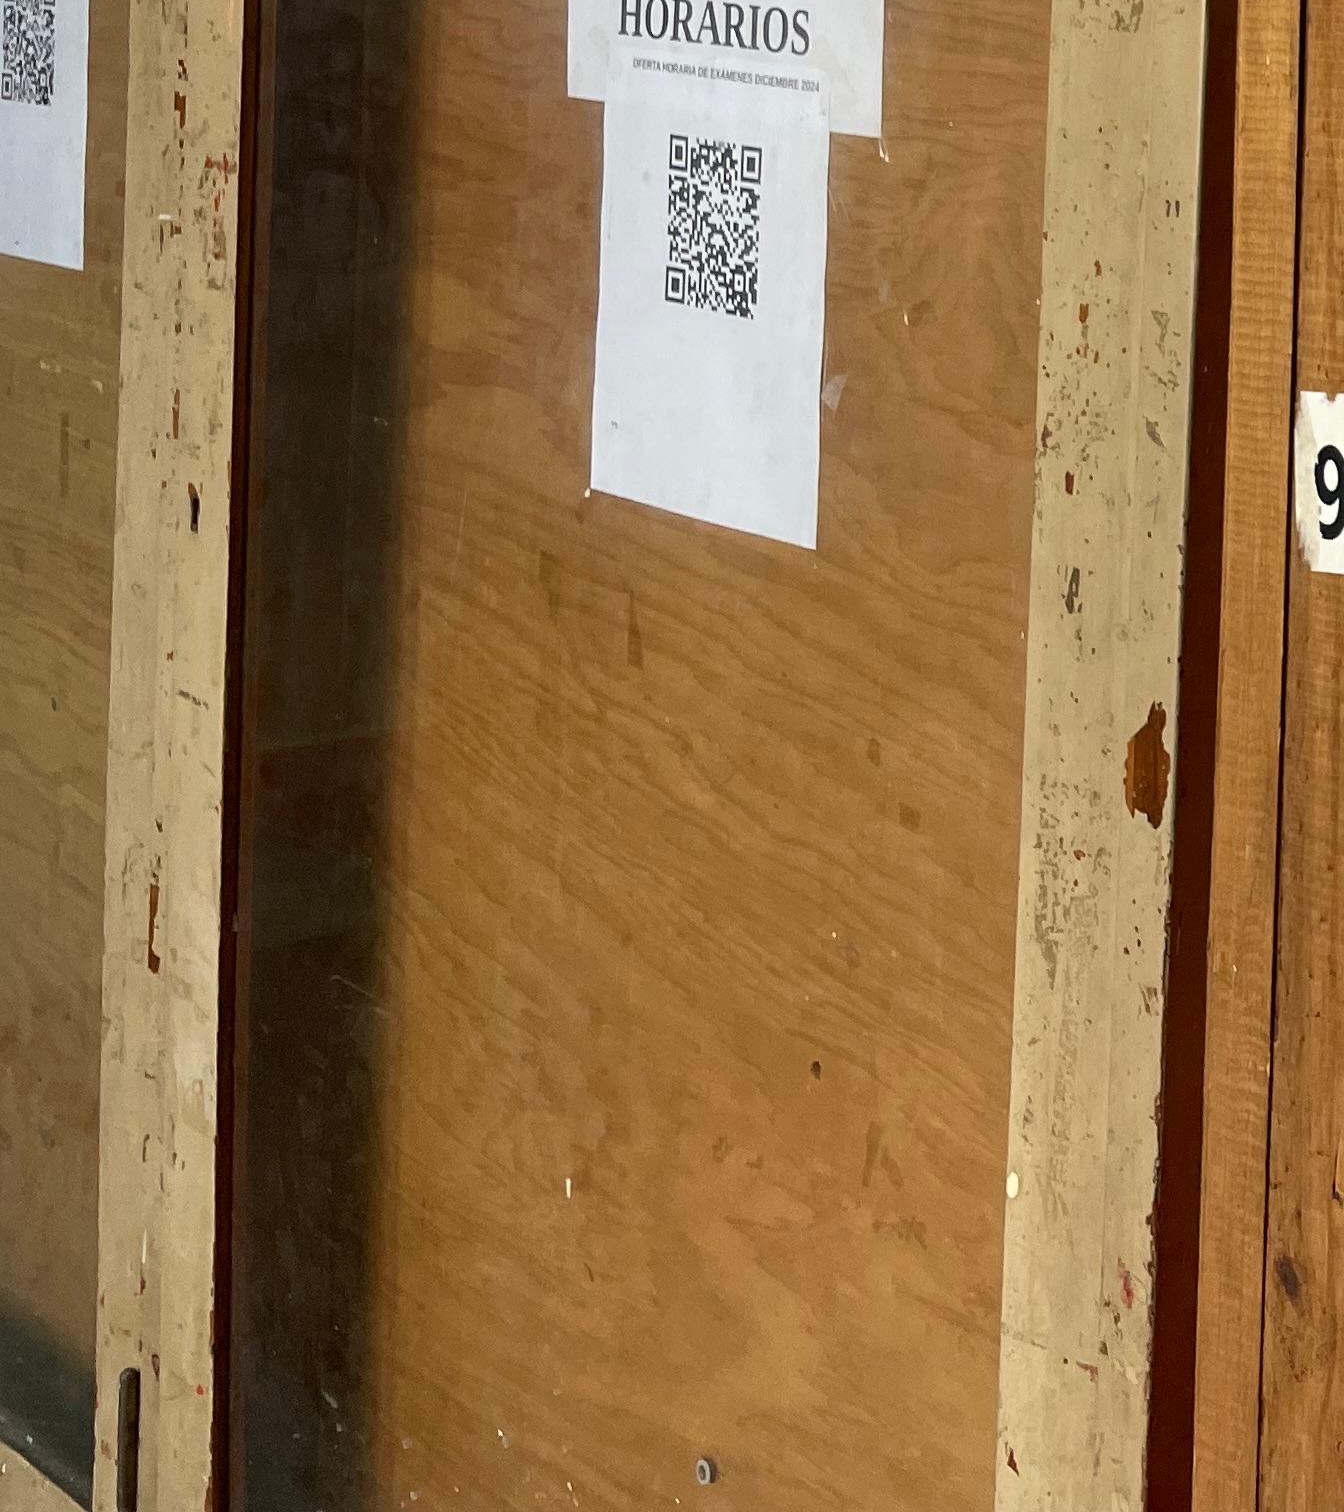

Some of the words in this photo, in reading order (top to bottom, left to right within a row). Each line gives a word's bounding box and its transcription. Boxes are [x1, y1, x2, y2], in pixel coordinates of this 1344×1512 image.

[632, 57, 661, 72] OFERTA
[662, 63, 696, 77] HORARIA
[697, 65, 708, 79] DE
[710, 67, 752, 84] EXÁMENES
[754, 73, 799, 90] DICIEMBRE
[801, 79, 820, 93] 2024
